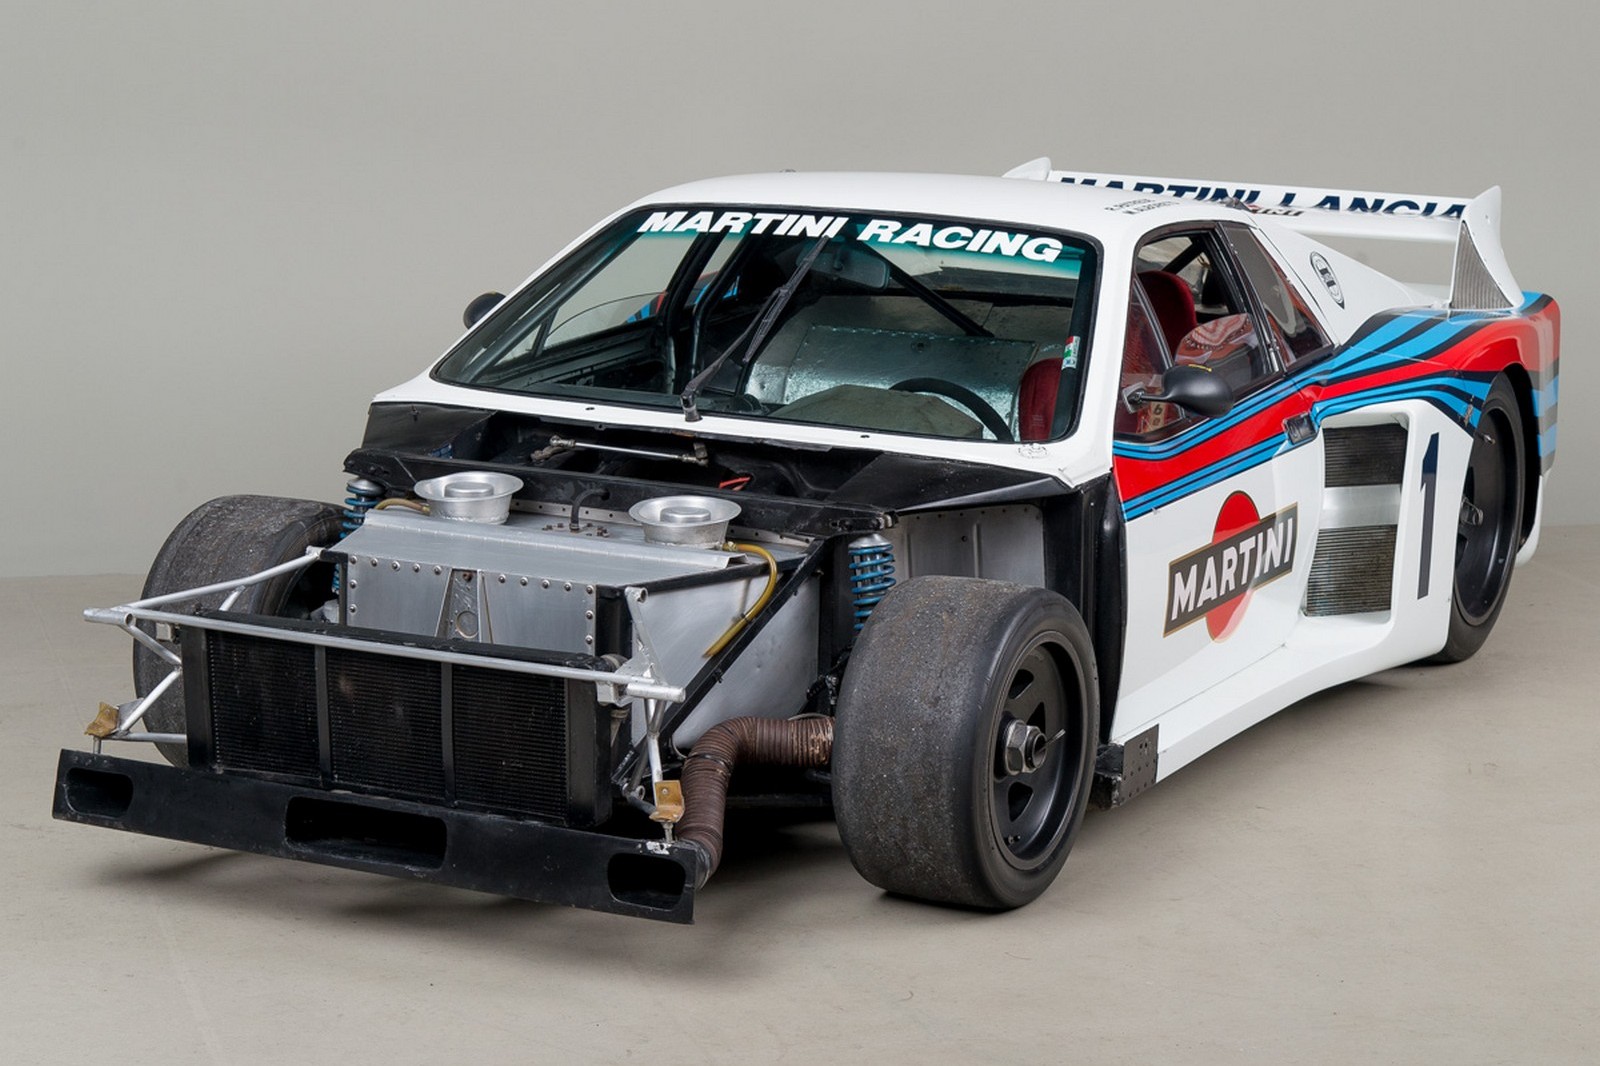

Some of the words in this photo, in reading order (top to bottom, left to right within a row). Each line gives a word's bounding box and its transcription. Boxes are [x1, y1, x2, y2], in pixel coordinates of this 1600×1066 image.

[636, 211, 850, 239] MARTINI
[856, 219, 1063, 263] RACING
[1417, 432, 1440, 600] 1
[1171, 517, 1293, 621] MARTINI
